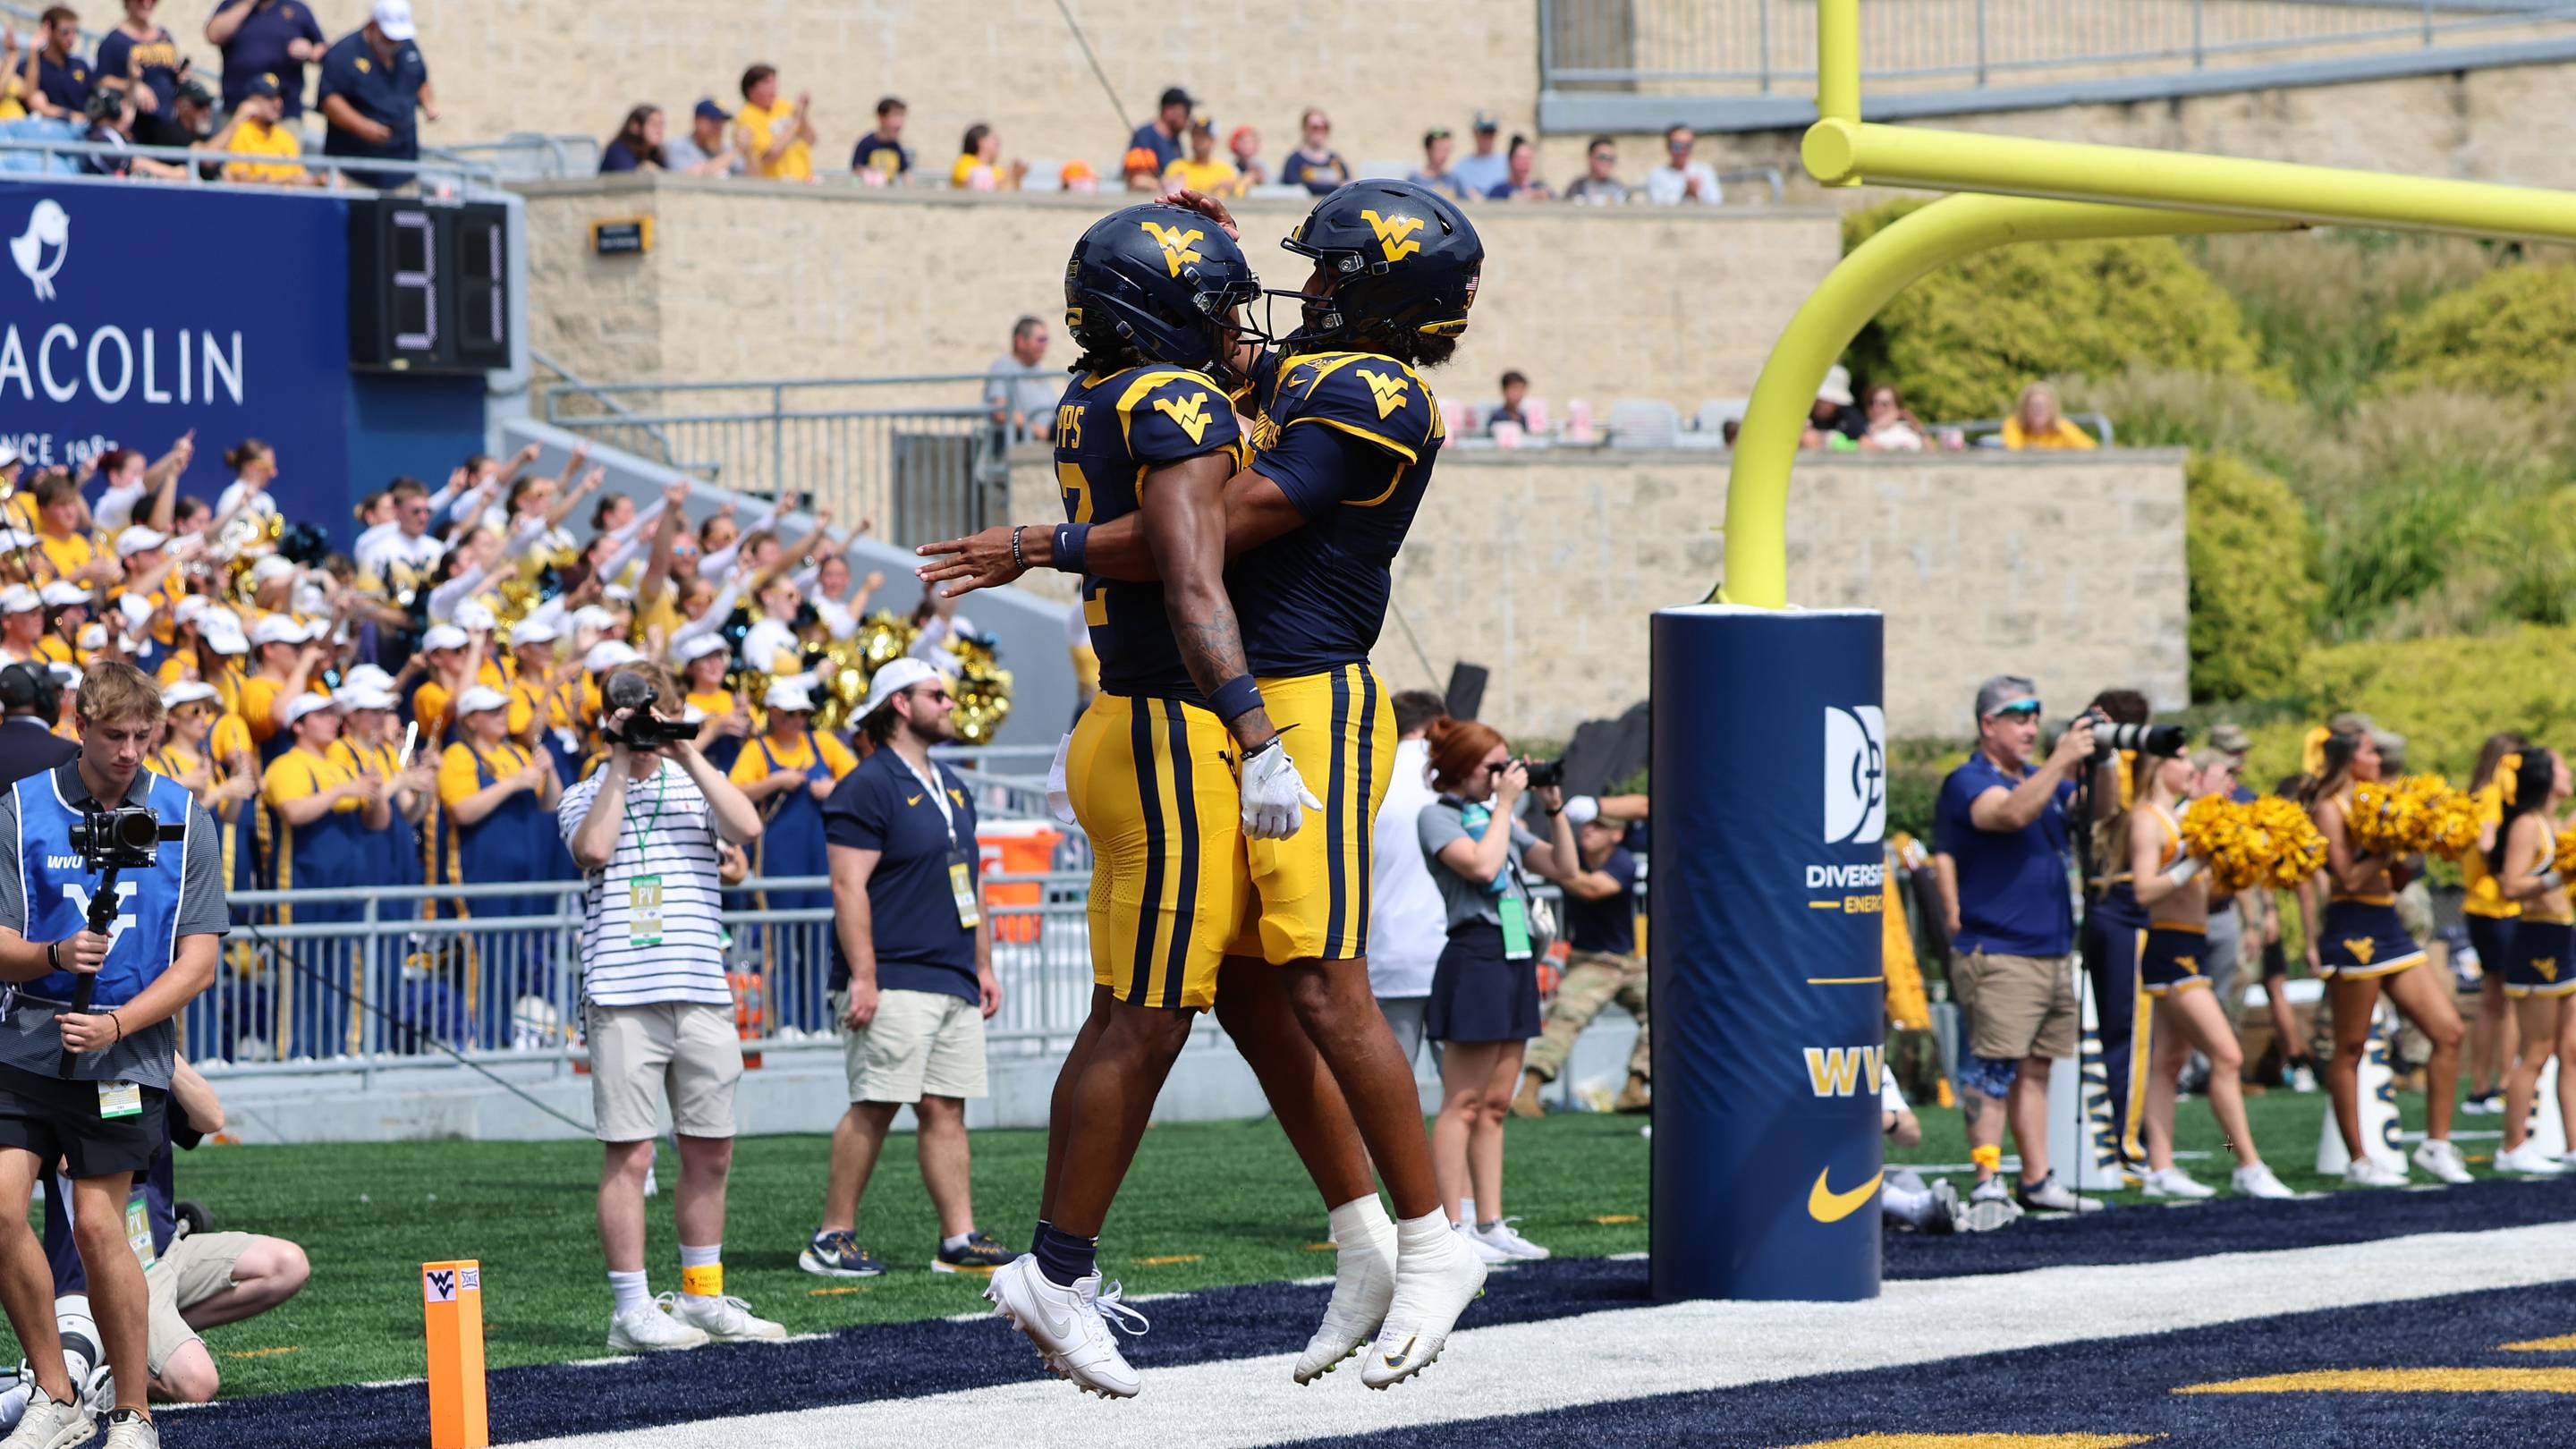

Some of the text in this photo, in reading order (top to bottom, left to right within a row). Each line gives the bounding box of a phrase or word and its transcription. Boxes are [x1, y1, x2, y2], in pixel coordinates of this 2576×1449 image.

[393, 210, 504, 350] 31
[47, 855, 83, 869] WVU
[638, 886, 654, 905] PV
